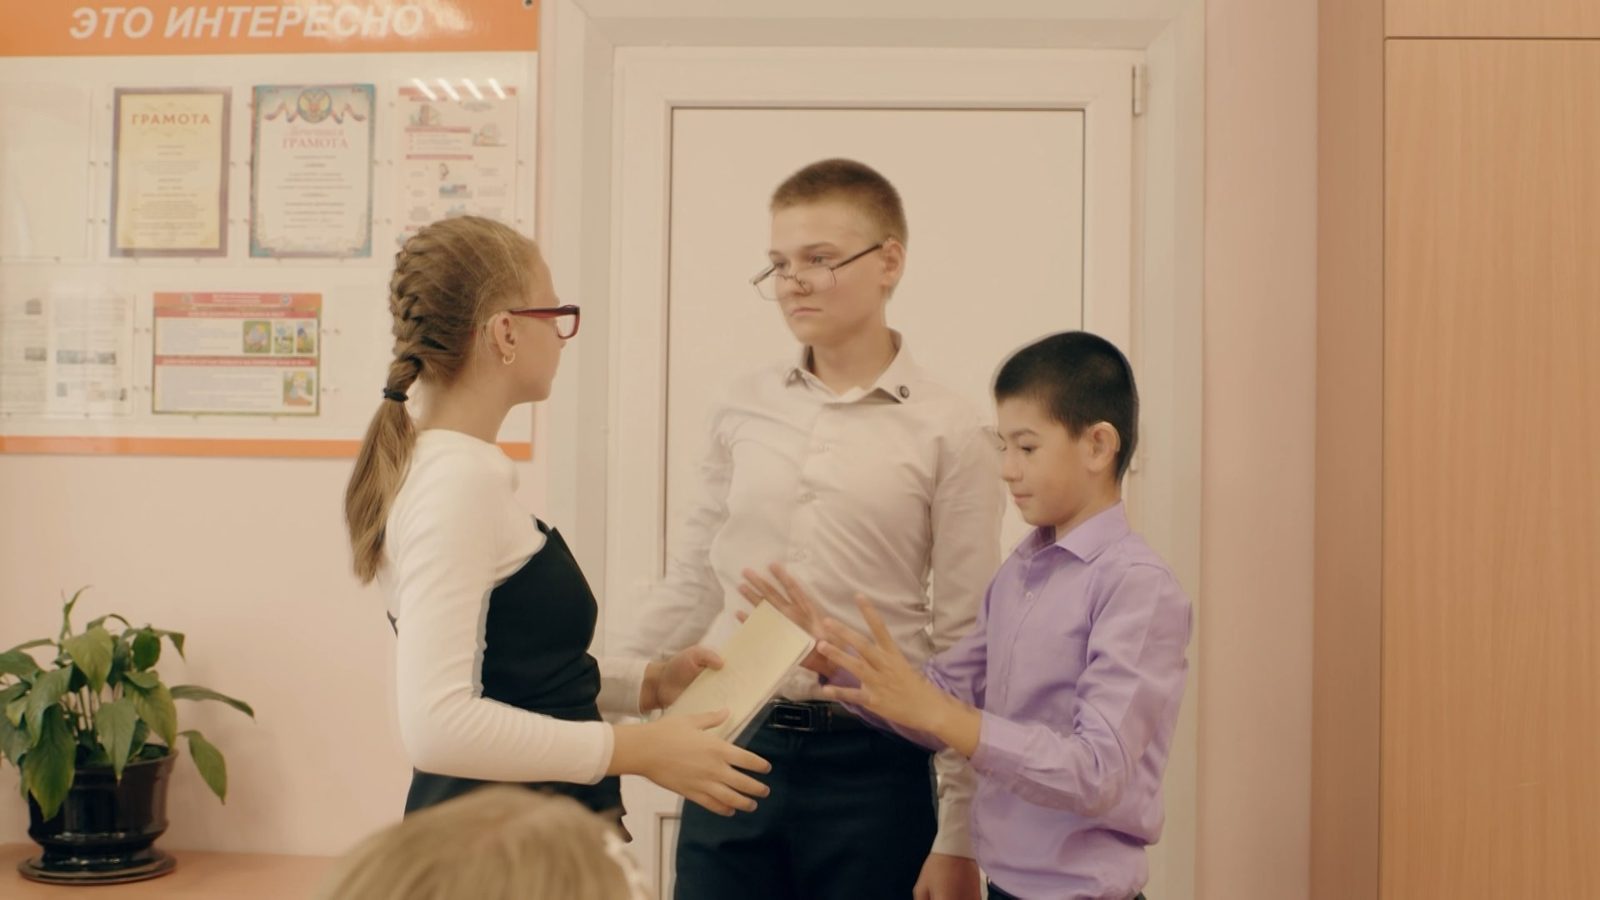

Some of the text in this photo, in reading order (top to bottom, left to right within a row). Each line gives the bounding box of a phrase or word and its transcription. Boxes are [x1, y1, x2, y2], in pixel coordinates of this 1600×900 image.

[70, 4, 424, 39] ЭТО ИНТЕРЕСНО
[131, 112, 212, 126] ГРАМОТА
[281, 137, 350, 150] ГРАМОТА
